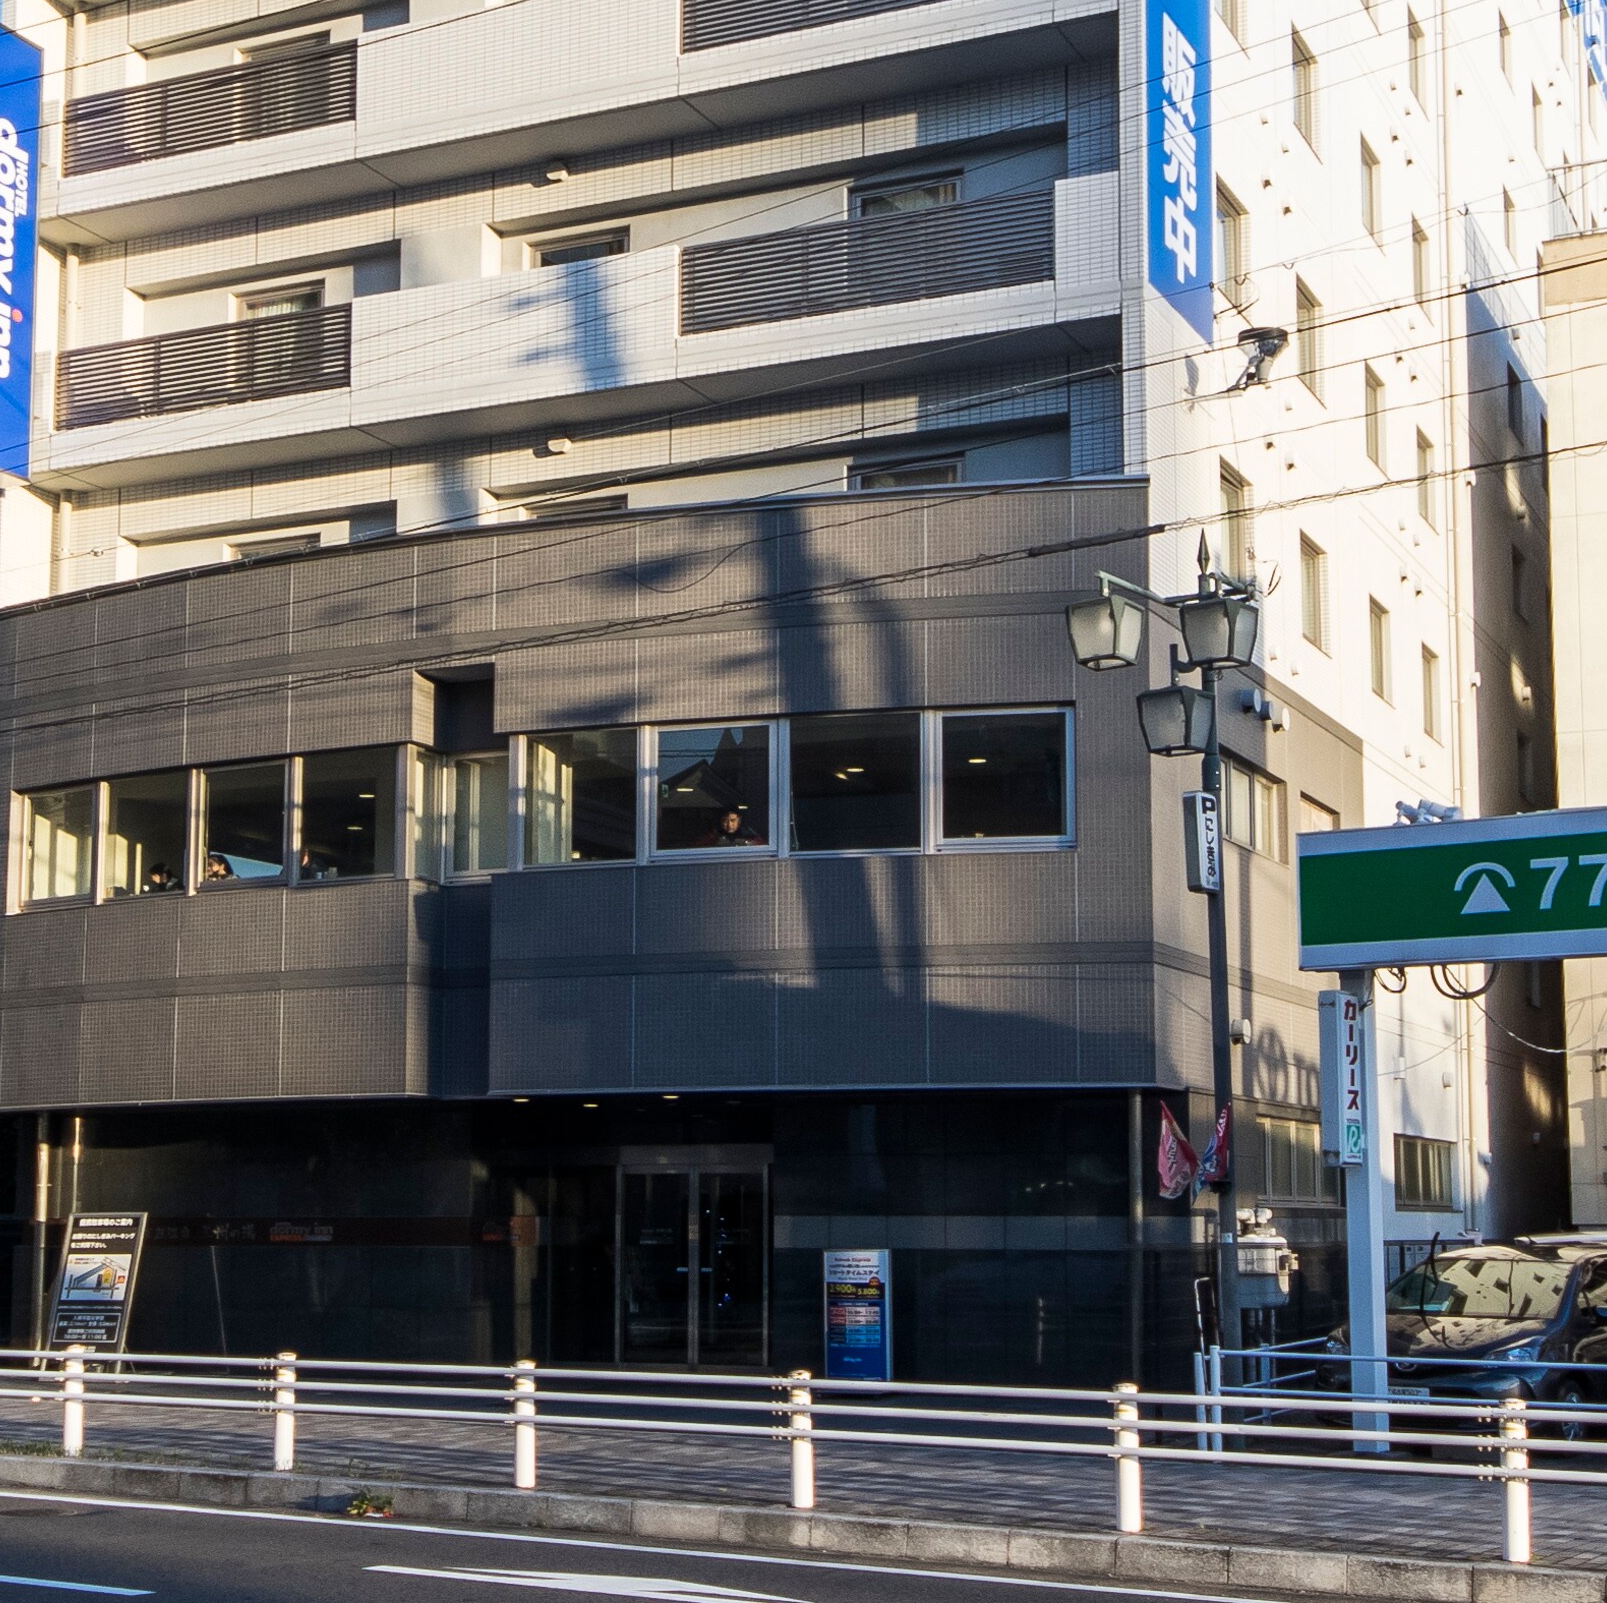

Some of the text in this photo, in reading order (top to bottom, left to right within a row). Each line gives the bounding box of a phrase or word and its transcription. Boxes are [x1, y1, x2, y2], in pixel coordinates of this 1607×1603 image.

[14, 161, 29, 218] HOTEL
[1161, 11, 1197, 285] 販売中
[1204, 816, 1217, 878] にしきみ
[1343, 999, 1360, 1110] カーリース
